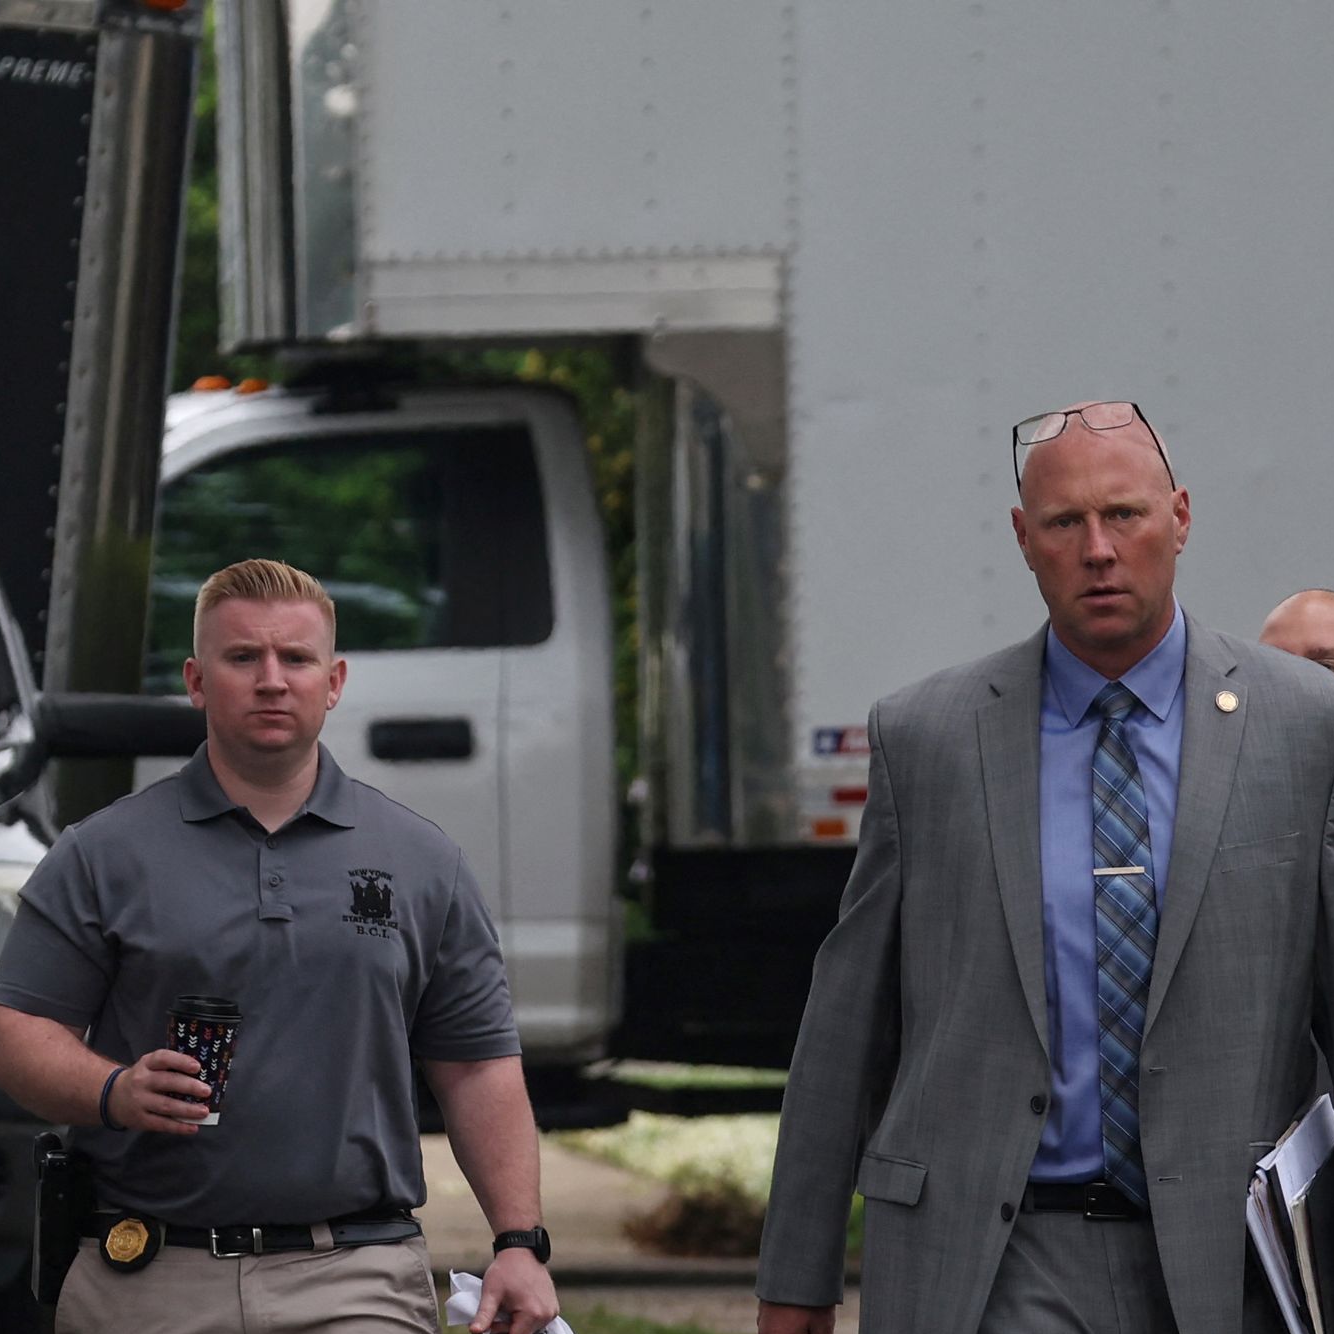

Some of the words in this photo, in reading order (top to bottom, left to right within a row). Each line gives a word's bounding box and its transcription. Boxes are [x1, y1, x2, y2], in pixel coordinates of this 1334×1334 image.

[348, 868, 368, 878] NEW
[369, 868, 393, 881] YORK
[342, 914, 368, 925] STATE
[371, 918, 399, 930] POLICE
[356, 925, 390, 939] B.C.I.
